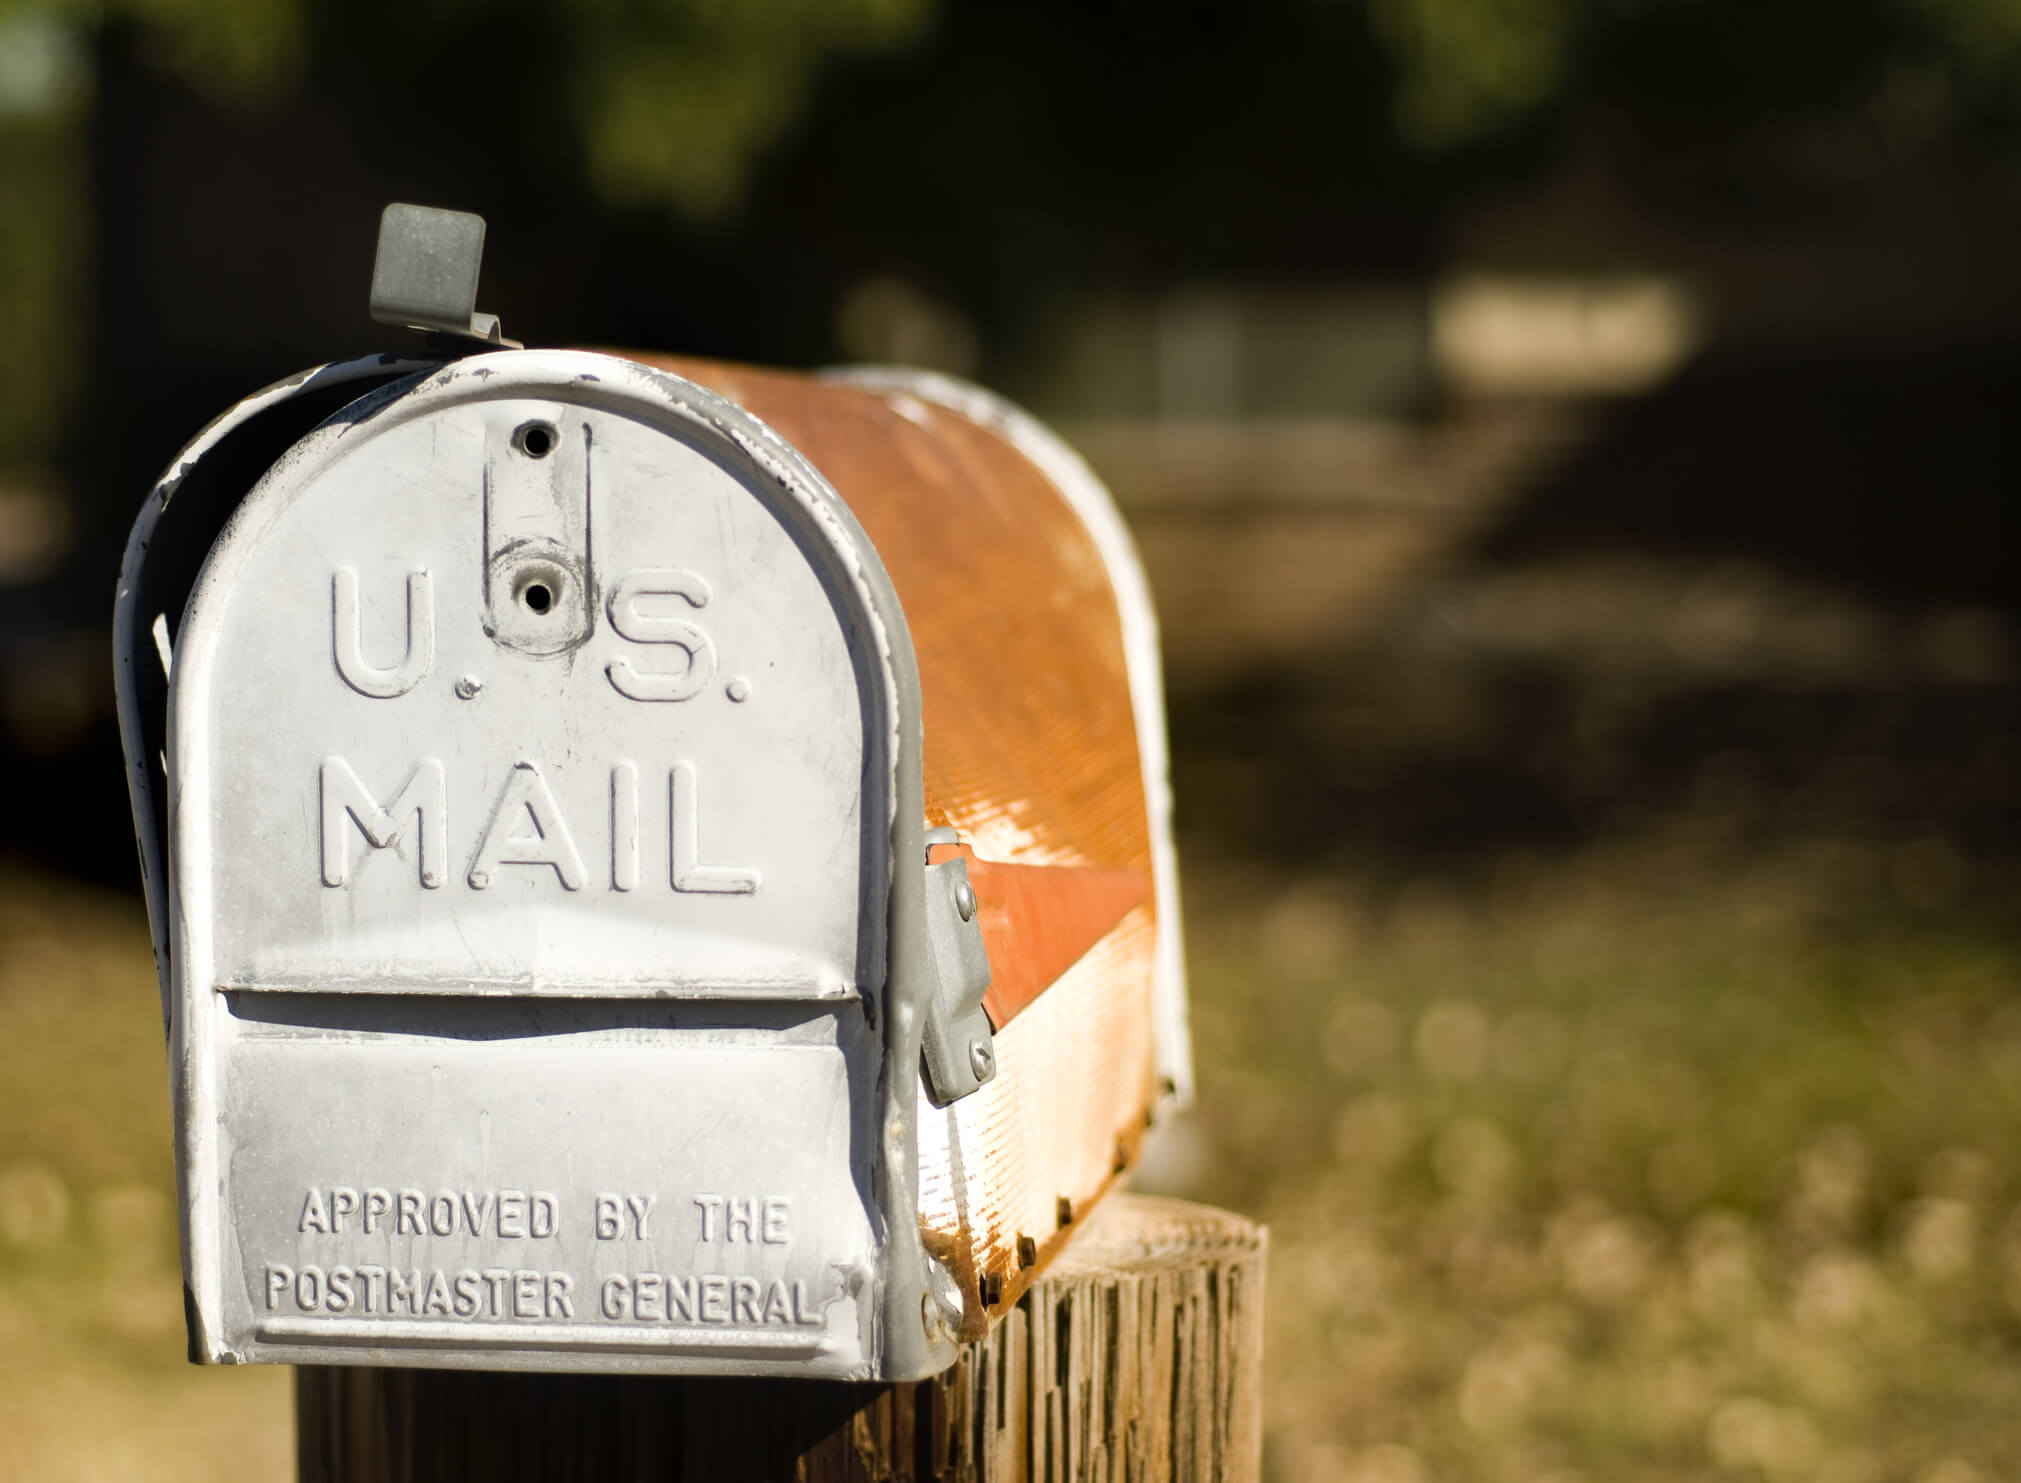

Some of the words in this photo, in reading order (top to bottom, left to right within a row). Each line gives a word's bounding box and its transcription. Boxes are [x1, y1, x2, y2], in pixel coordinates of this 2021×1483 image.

[319, 755, 763, 895] MAIL
[299, 1186, 559, 1239] APPROVED
[595, 1192, 657, 1241] BY
[694, 1193, 792, 1245] THE
[265, 1263, 576, 1319] POSTMASTER
[600, 1272, 826, 1327] GENERAL
